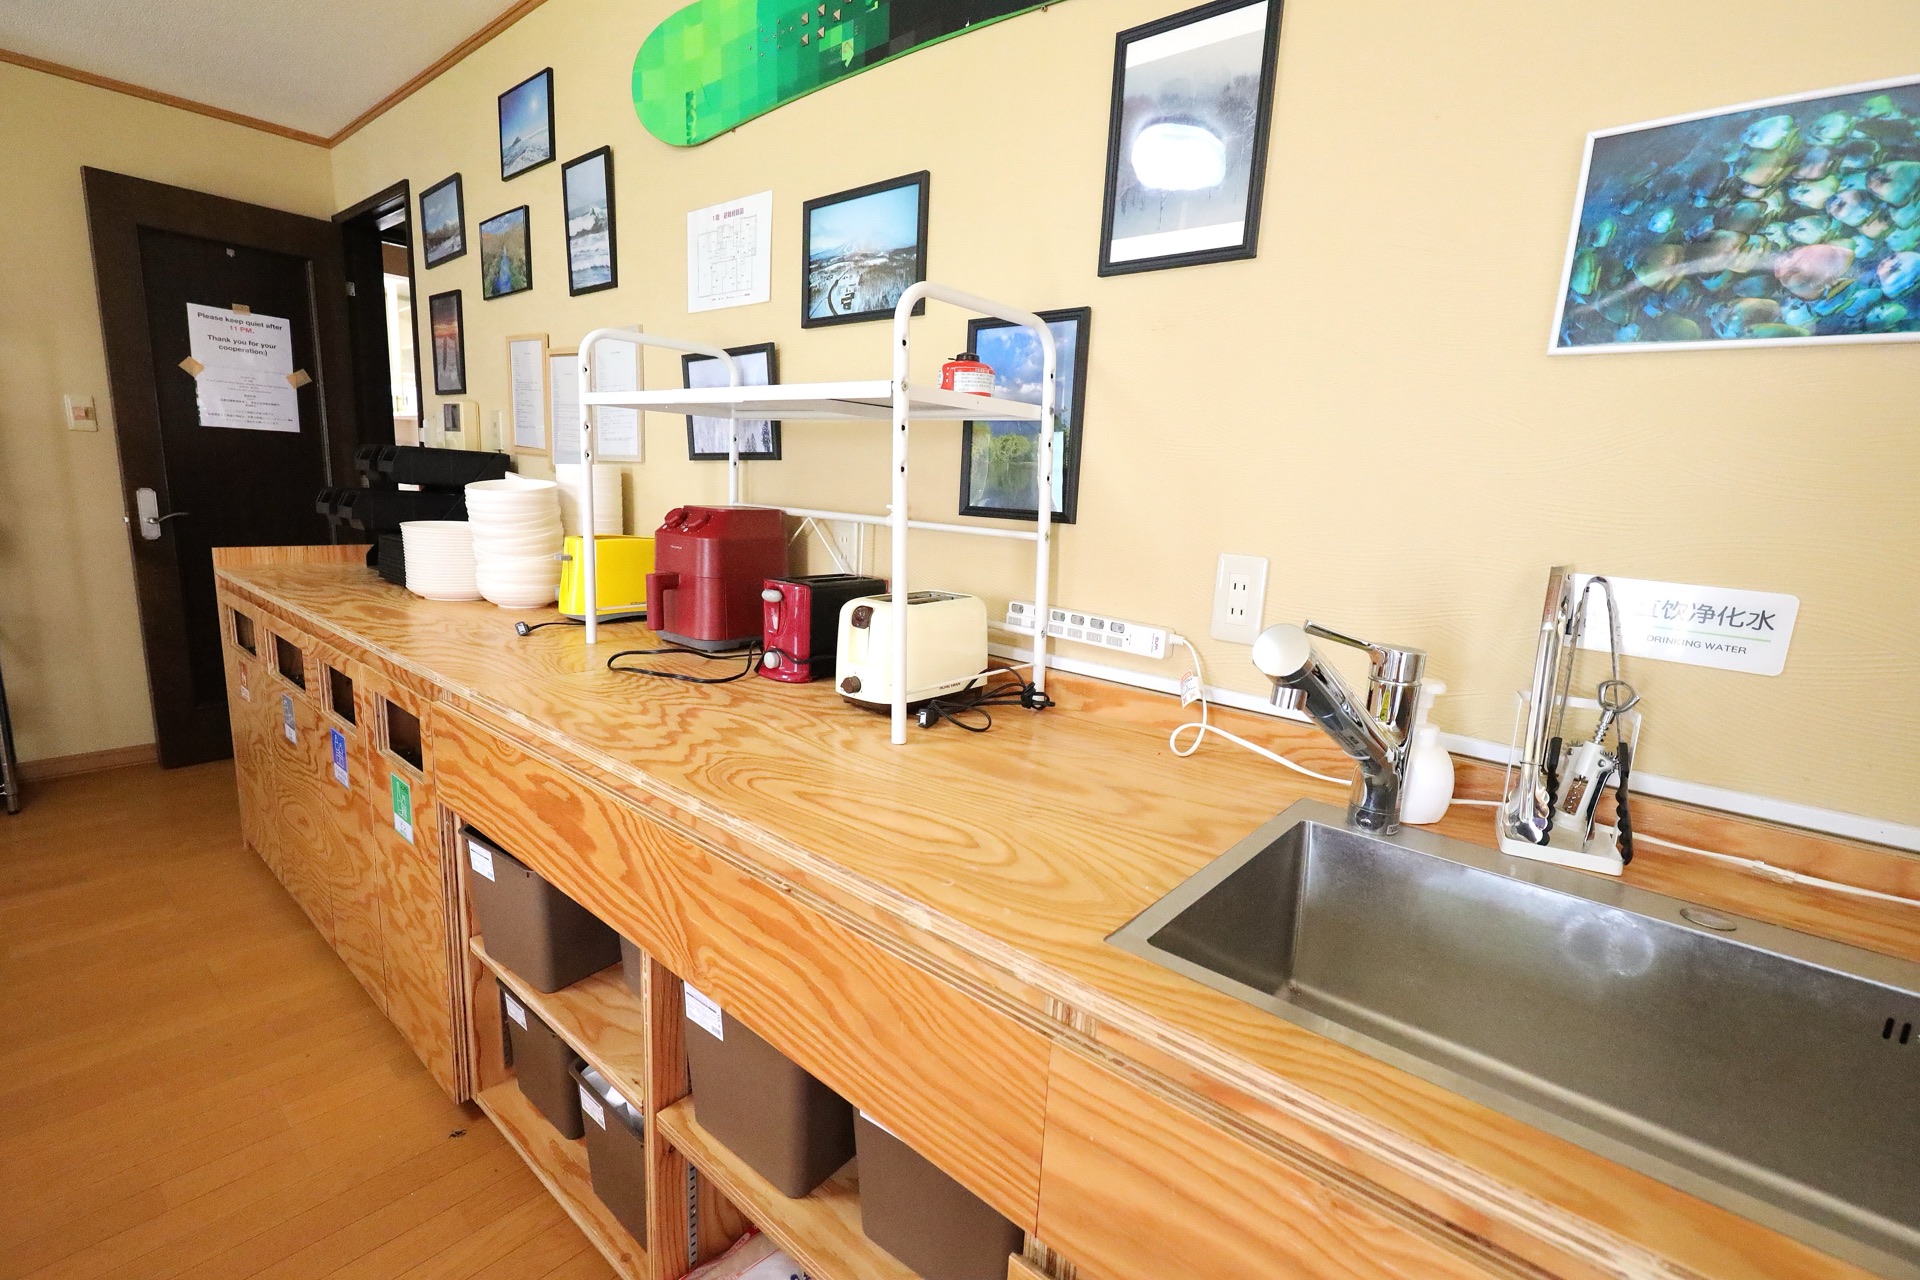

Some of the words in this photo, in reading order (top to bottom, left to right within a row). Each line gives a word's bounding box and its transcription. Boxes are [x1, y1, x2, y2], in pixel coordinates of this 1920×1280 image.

[197, 311, 224, 321] Please
[225, 316, 244, 325] keep
[245, 320, 264, 328] quiet
[266, 323, 283, 331] after
[240, 326, 255, 334] PM.
[207, 334, 231, 343] Thank
[1646, 634, 1702, 649] DRINKING
[1704, 642, 1747, 655] WATER
